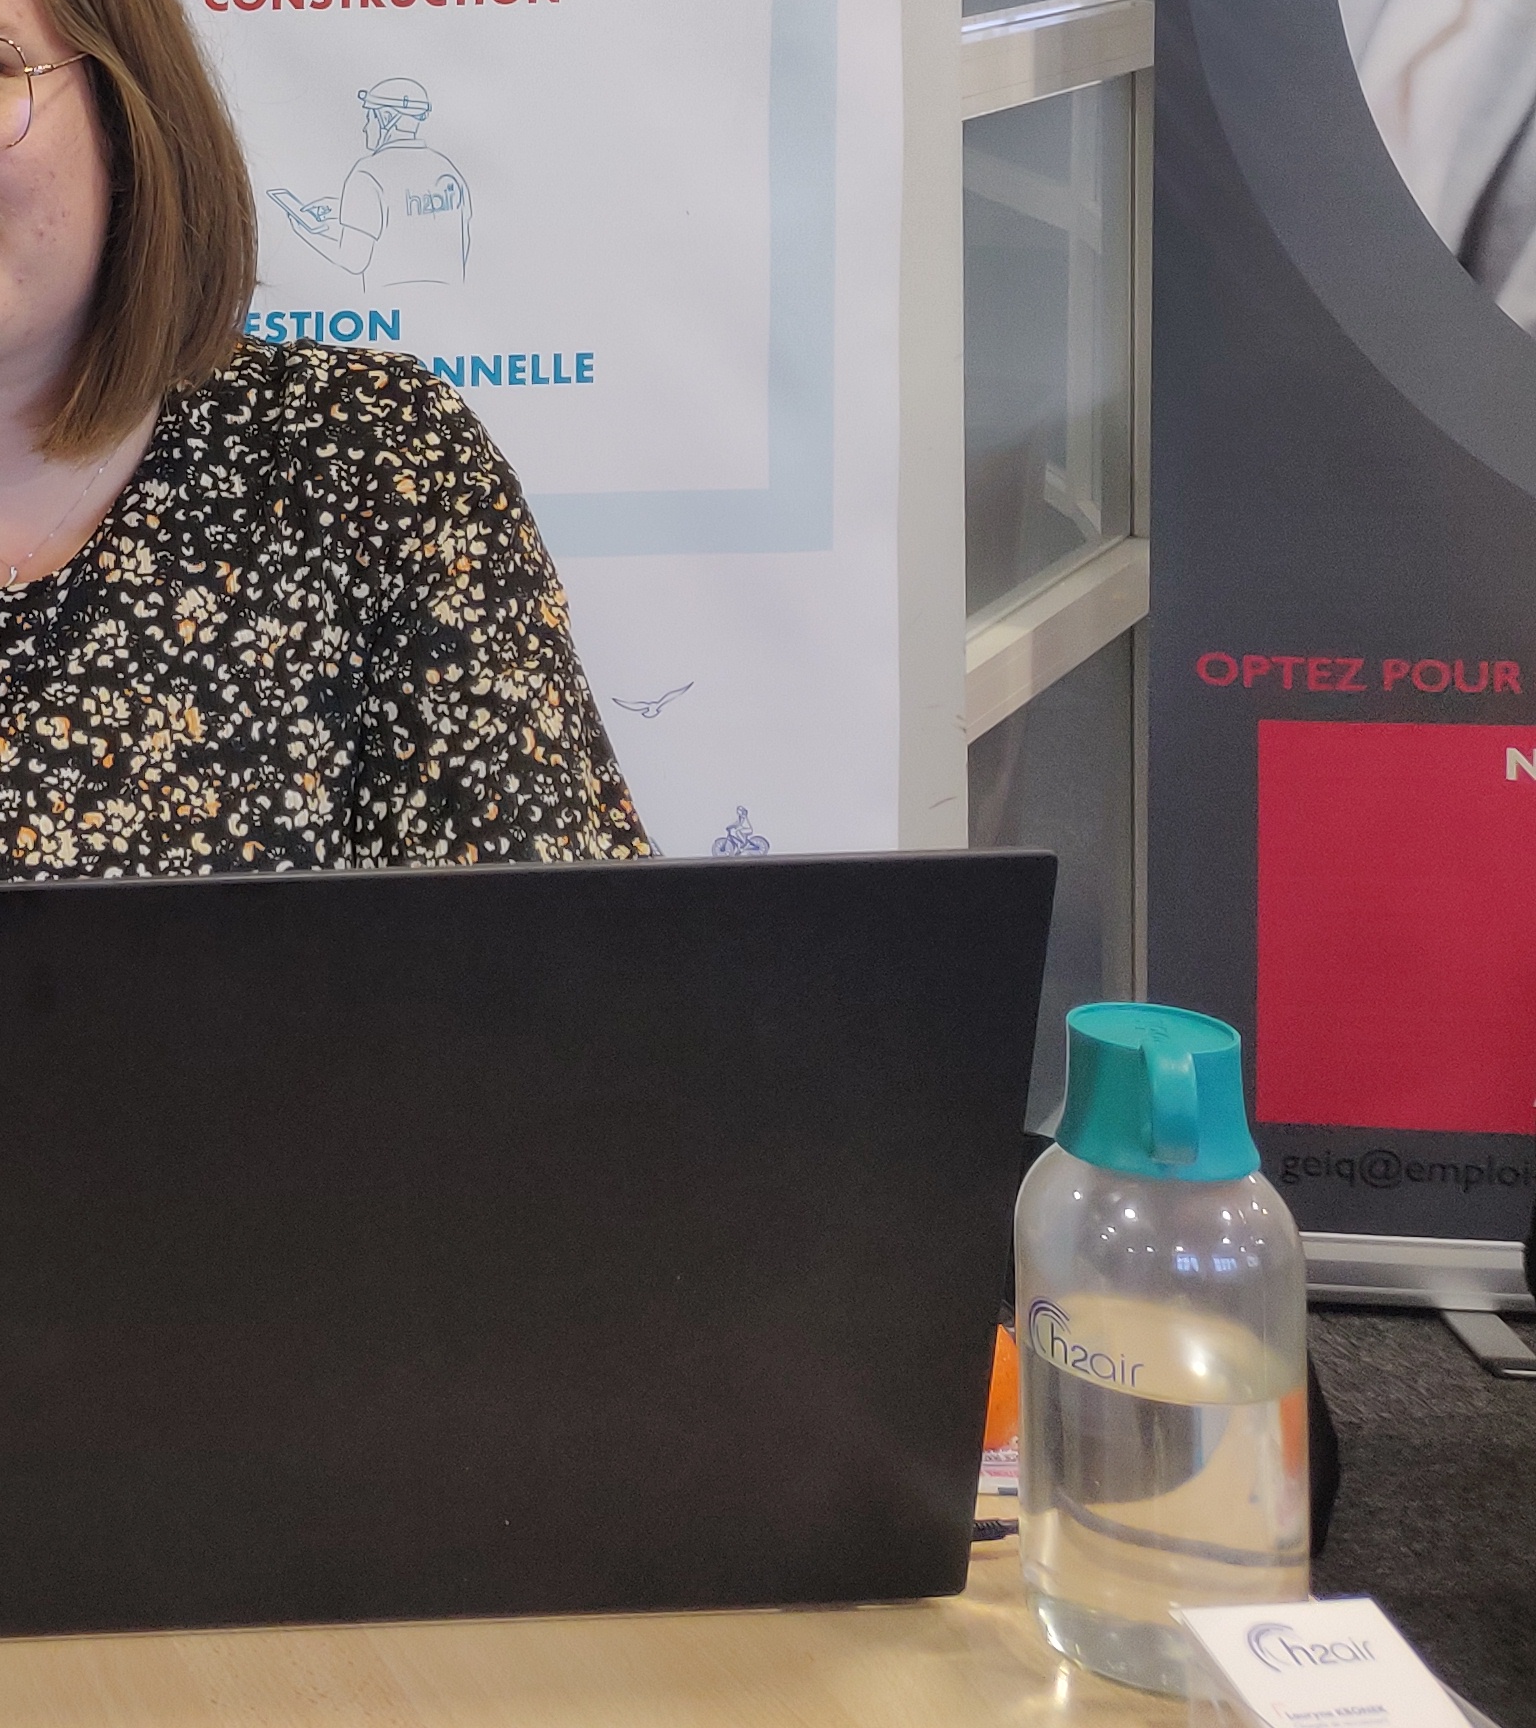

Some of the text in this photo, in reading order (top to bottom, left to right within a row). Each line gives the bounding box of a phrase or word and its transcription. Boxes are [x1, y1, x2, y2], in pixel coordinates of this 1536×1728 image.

[242, 308, 401, 345] ESTION
[1196, 651, 1523, 694] OPTEZ POUR
[1048, 1319, 1145, 1388] h2air
[1278, 1635, 1376, 1666] h2air
